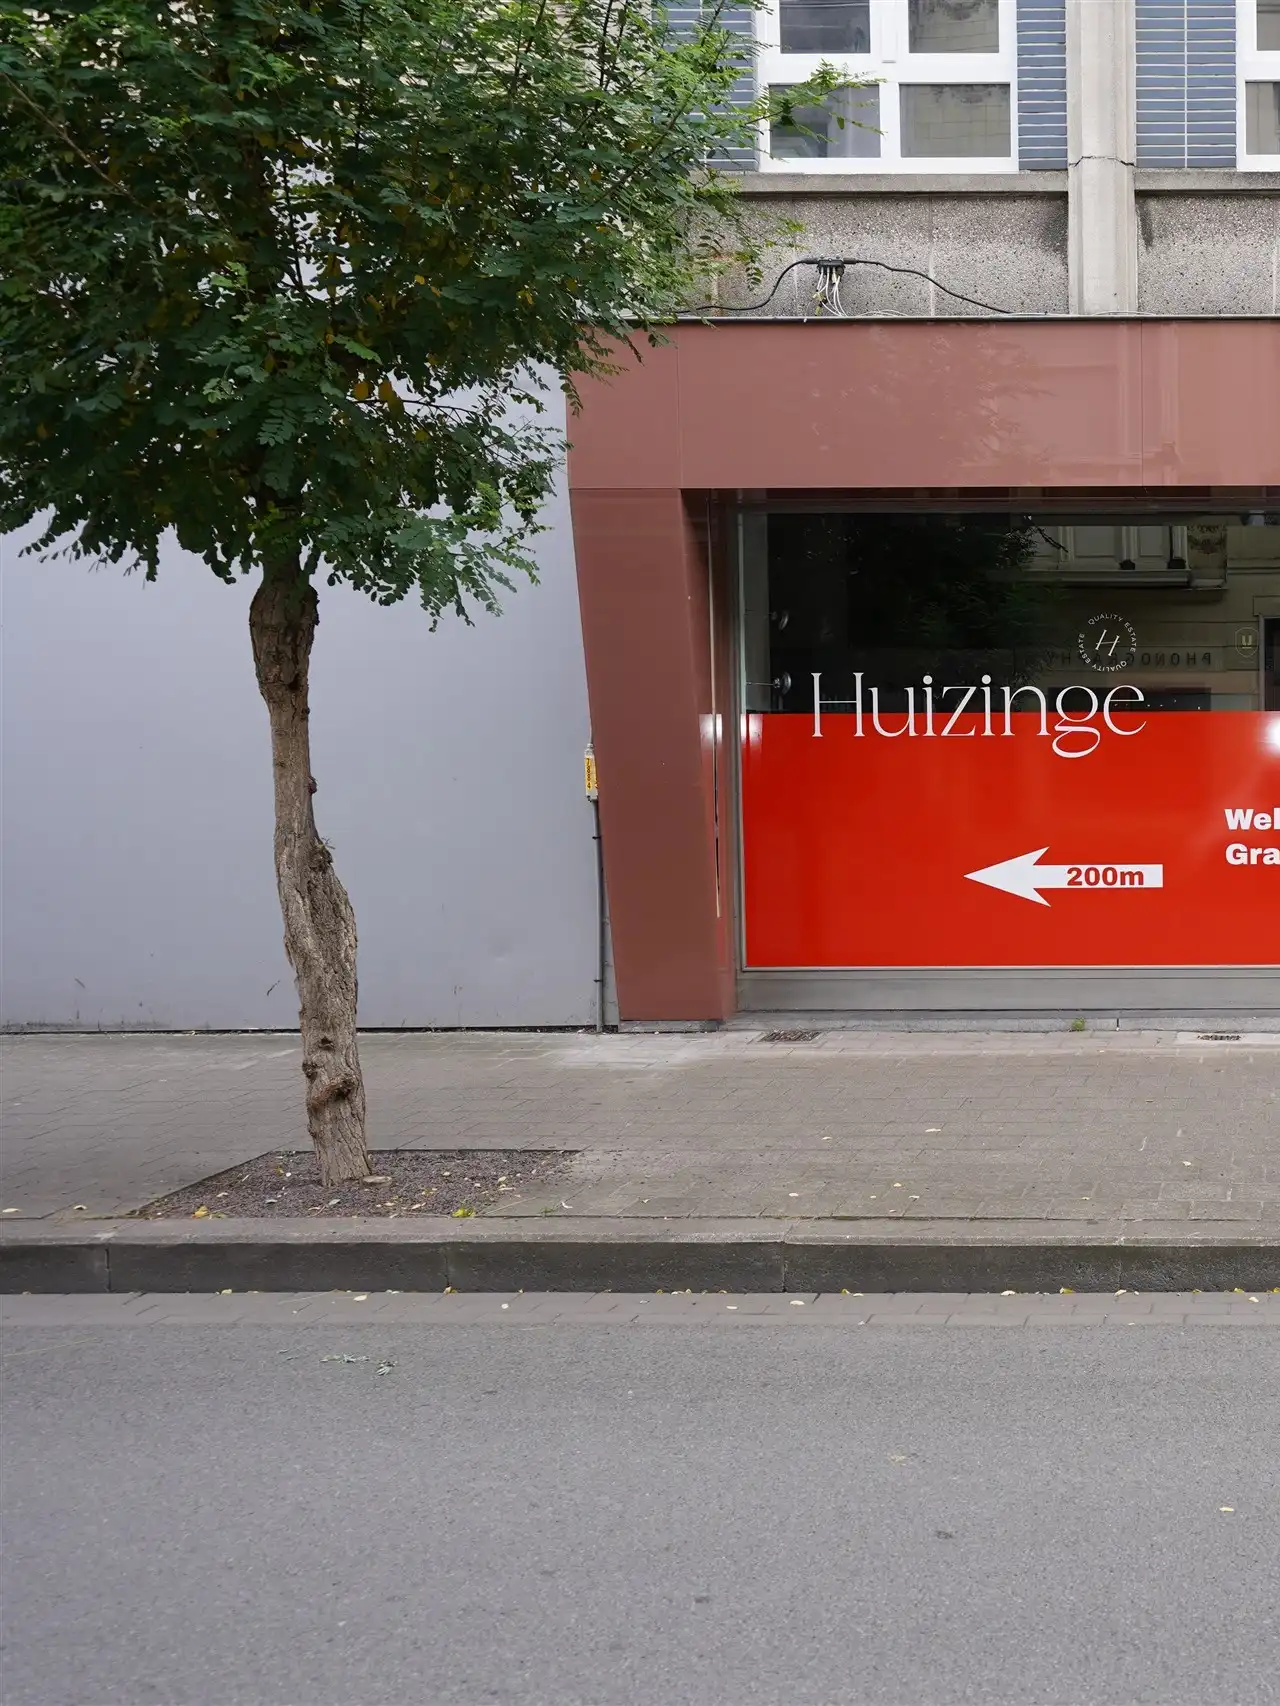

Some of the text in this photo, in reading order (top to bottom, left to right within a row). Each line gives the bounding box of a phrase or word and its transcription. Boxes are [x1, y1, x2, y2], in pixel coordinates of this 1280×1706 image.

[1078, 633, 1127, 672] QUALITY ESTATE
[1088, 613, 1137, 653] QUALITY ESTATE
[1095, 629, 1120, 656] H
[811, 672, 1147, 758] Huizinge
[1066, 866, 1145, 887] 200m
